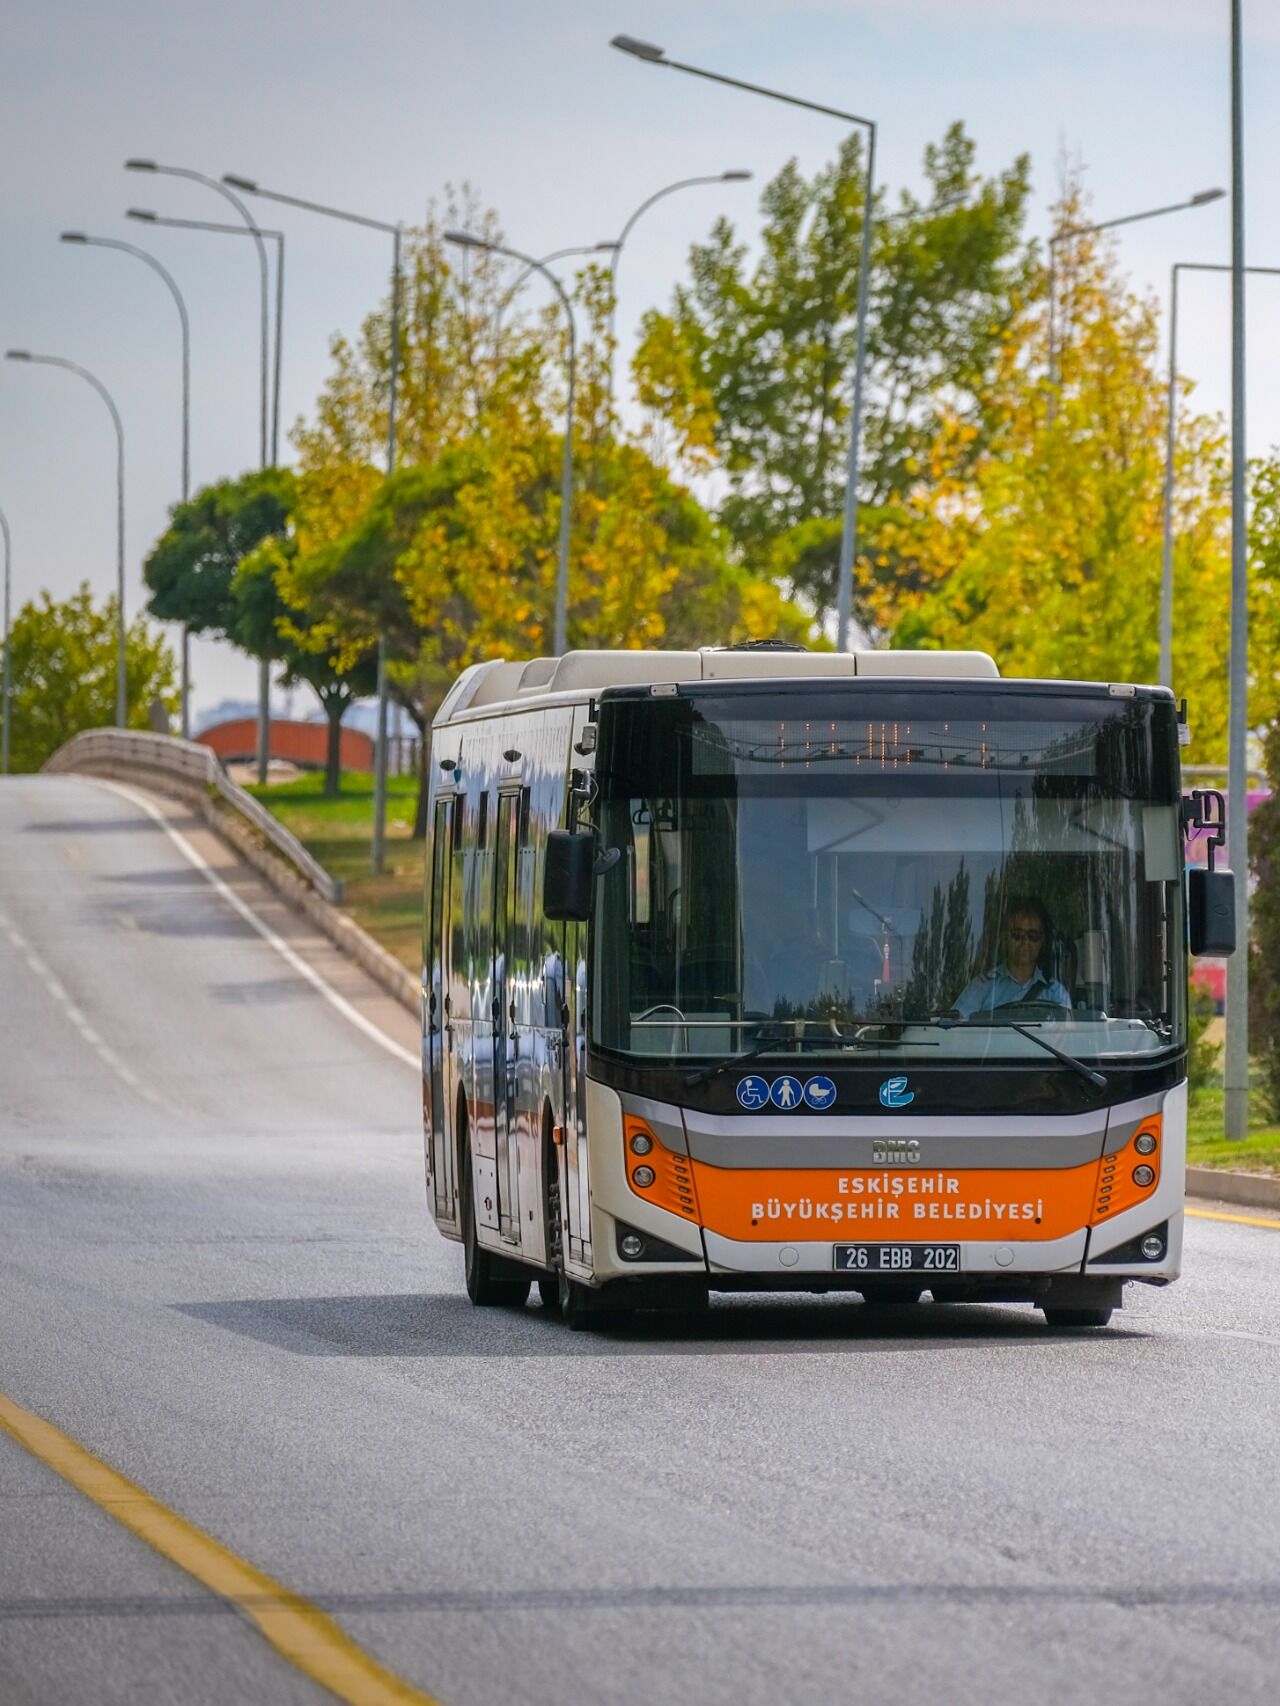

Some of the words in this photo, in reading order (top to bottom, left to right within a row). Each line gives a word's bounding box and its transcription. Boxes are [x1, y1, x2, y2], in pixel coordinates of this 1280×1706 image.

[873, 1140, 920, 1164] BMC
[838, 1172, 960, 1197] ESKİŞEHİR
[751, 1198, 900, 1223] BÜYÜKŞEHİR
[913, 1198, 1044, 1219] BELEDİYESİ
[846, 1247, 868, 1269] 26
[879, 1247, 913, 1269] EBB
[923, 1247, 957, 1269] 202
